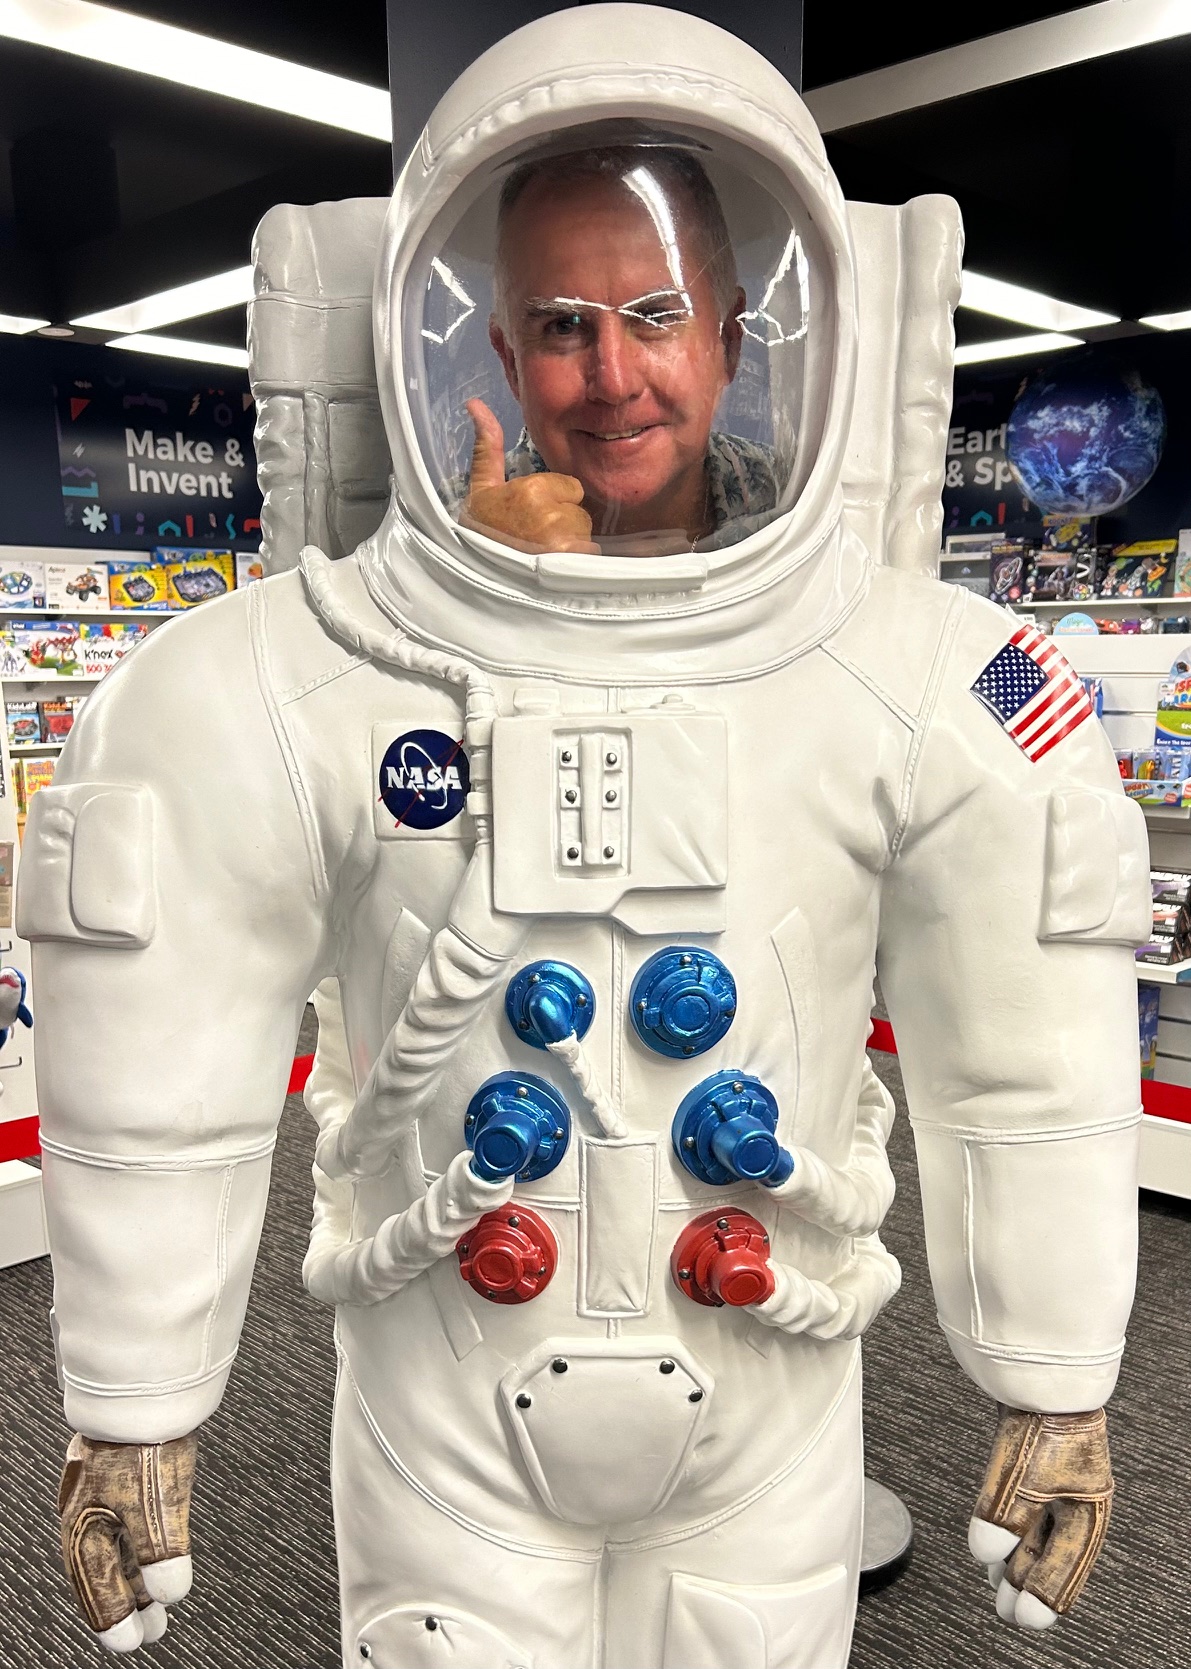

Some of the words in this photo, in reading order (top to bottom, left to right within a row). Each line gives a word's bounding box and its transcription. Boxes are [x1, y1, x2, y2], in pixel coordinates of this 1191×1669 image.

[125, 428, 214, 464] Make
[224, 438, 245, 467] &
[127, 463, 234, 499] Invent
[946, 459, 965, 488] &
[385, 766, 463, 790] NASA
